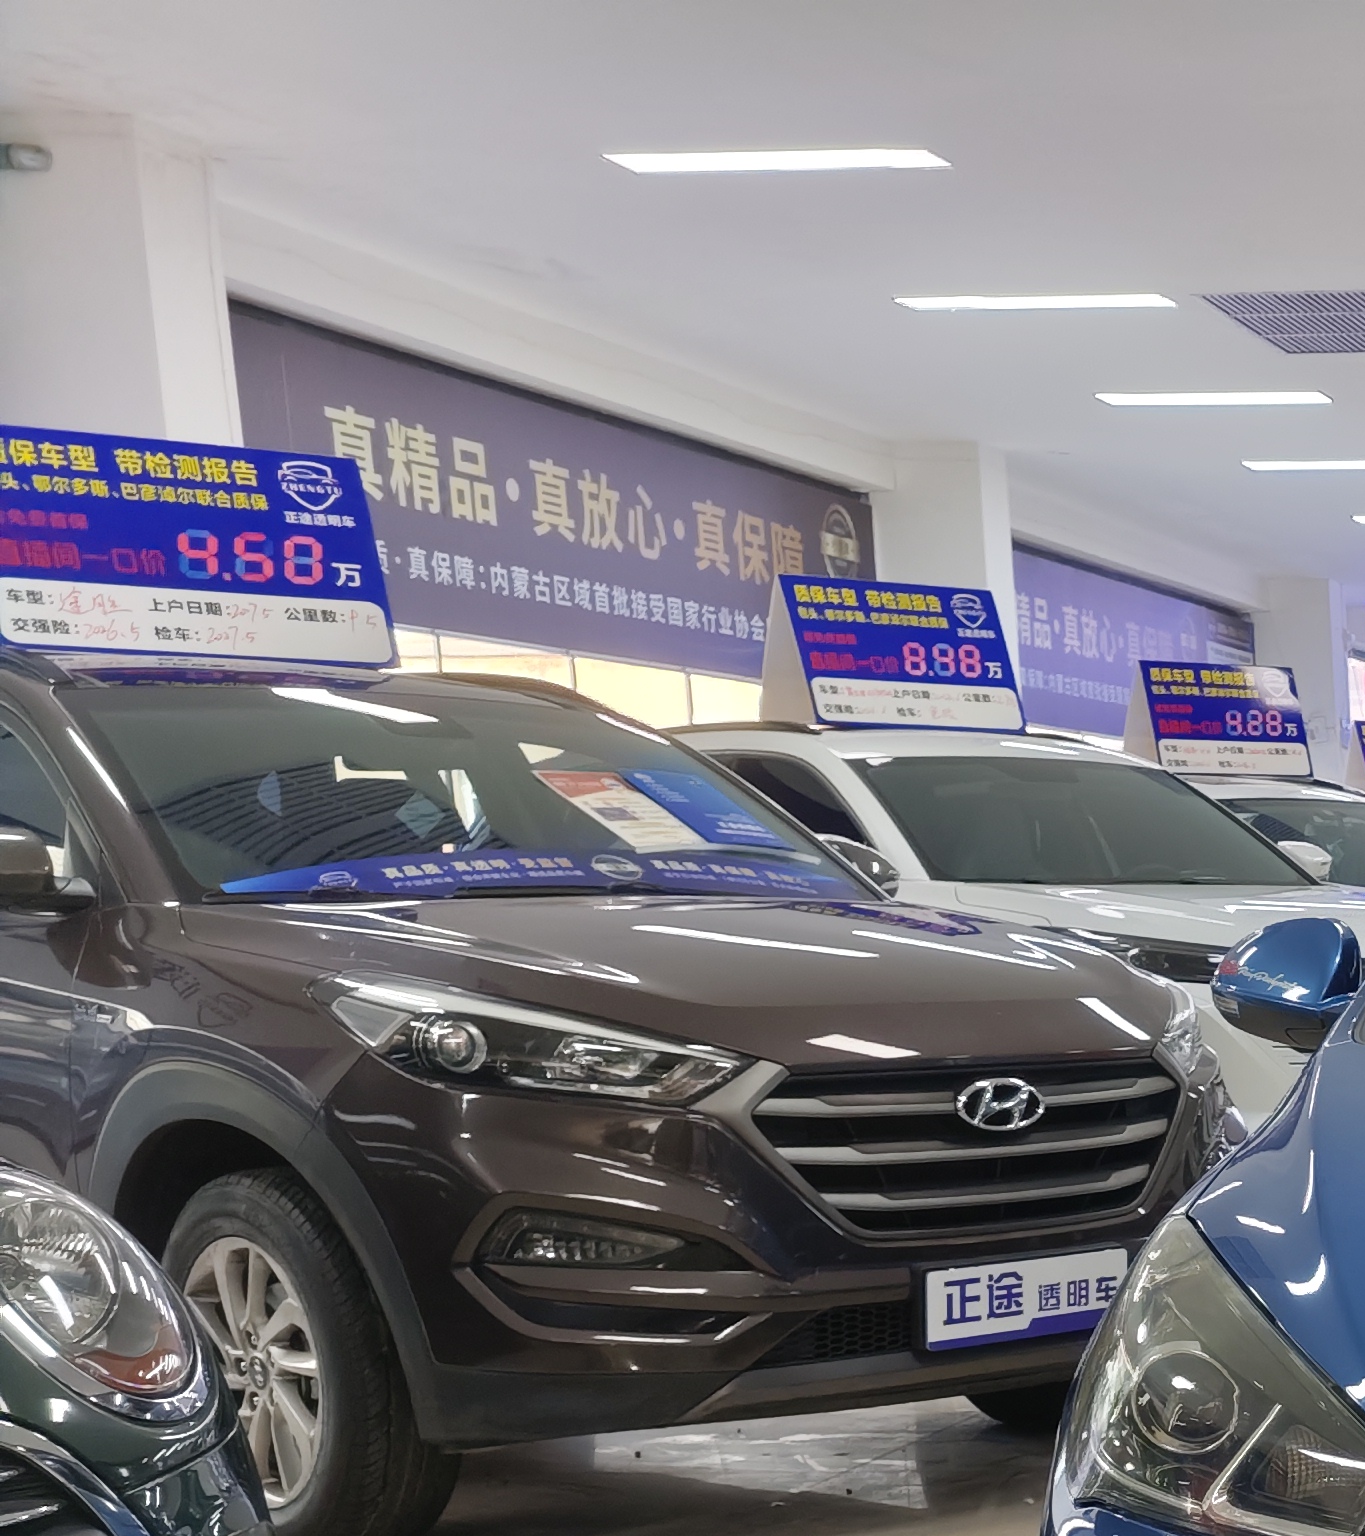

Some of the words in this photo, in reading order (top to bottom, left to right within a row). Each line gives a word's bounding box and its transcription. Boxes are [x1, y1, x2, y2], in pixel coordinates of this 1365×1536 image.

[0, 437, 98, 472] 保车型
[113, 448, 258, 487] 带检测报告
[330, 562, 362, 587] 万
[943, 1270, 1024, 1326] 正途
[1037, 1276, 1118, 1313] 透明车
